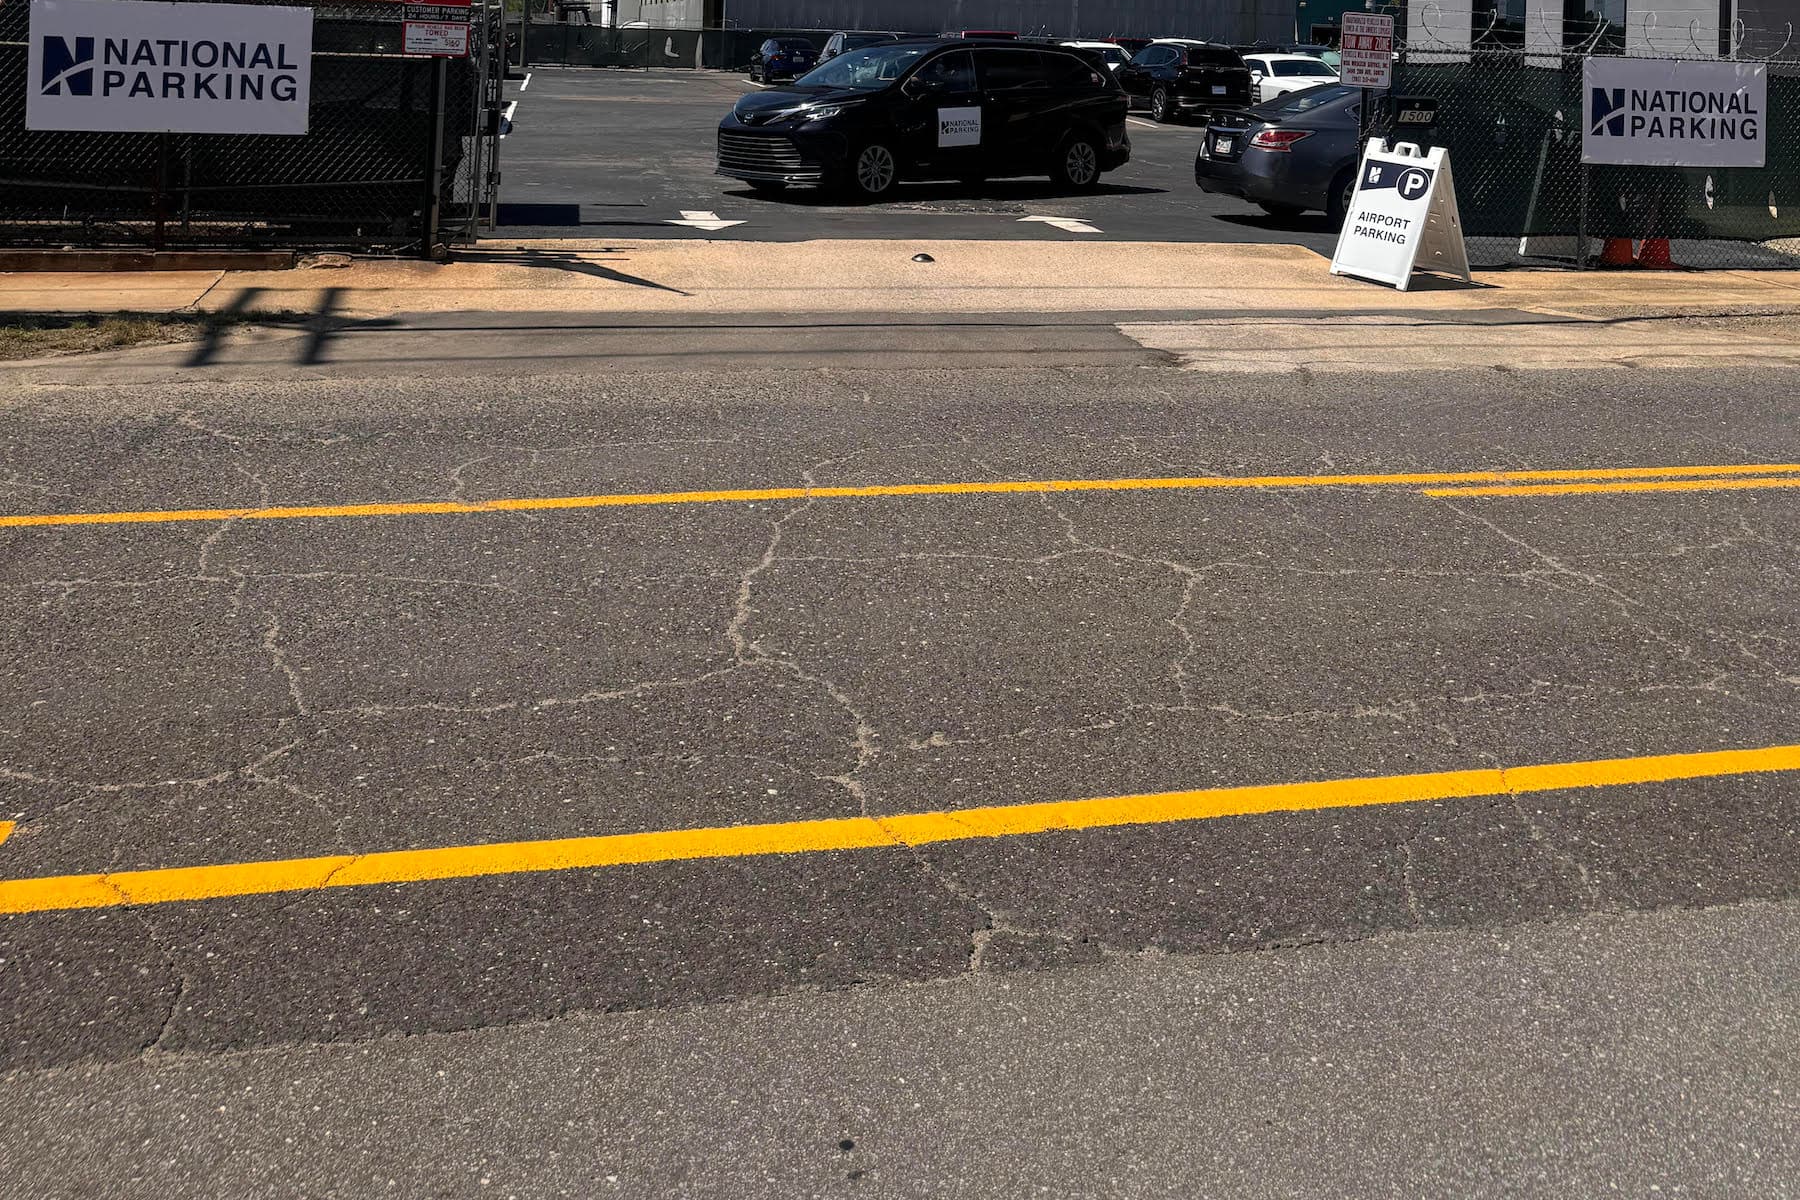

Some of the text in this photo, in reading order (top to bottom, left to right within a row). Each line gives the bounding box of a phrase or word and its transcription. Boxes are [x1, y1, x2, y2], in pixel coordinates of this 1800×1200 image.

[442, 7, 469, 15] PARKING
[1375, 37, 1390, 50] ZONE
[104, 38, 298, 70] NATIONAL
[103, 70, 298, 101] PARKING
[1631, 89, 1758, 114] NATIONAL
[1401, 112, 1432, 122] 1500
[1631, 115, 1758, 140] PARKING
[1404, 173, 1424, 195] P
[1358, 211, 1411, 230] AIRPORT
[1354, 226, 1406, 244] PARKING
